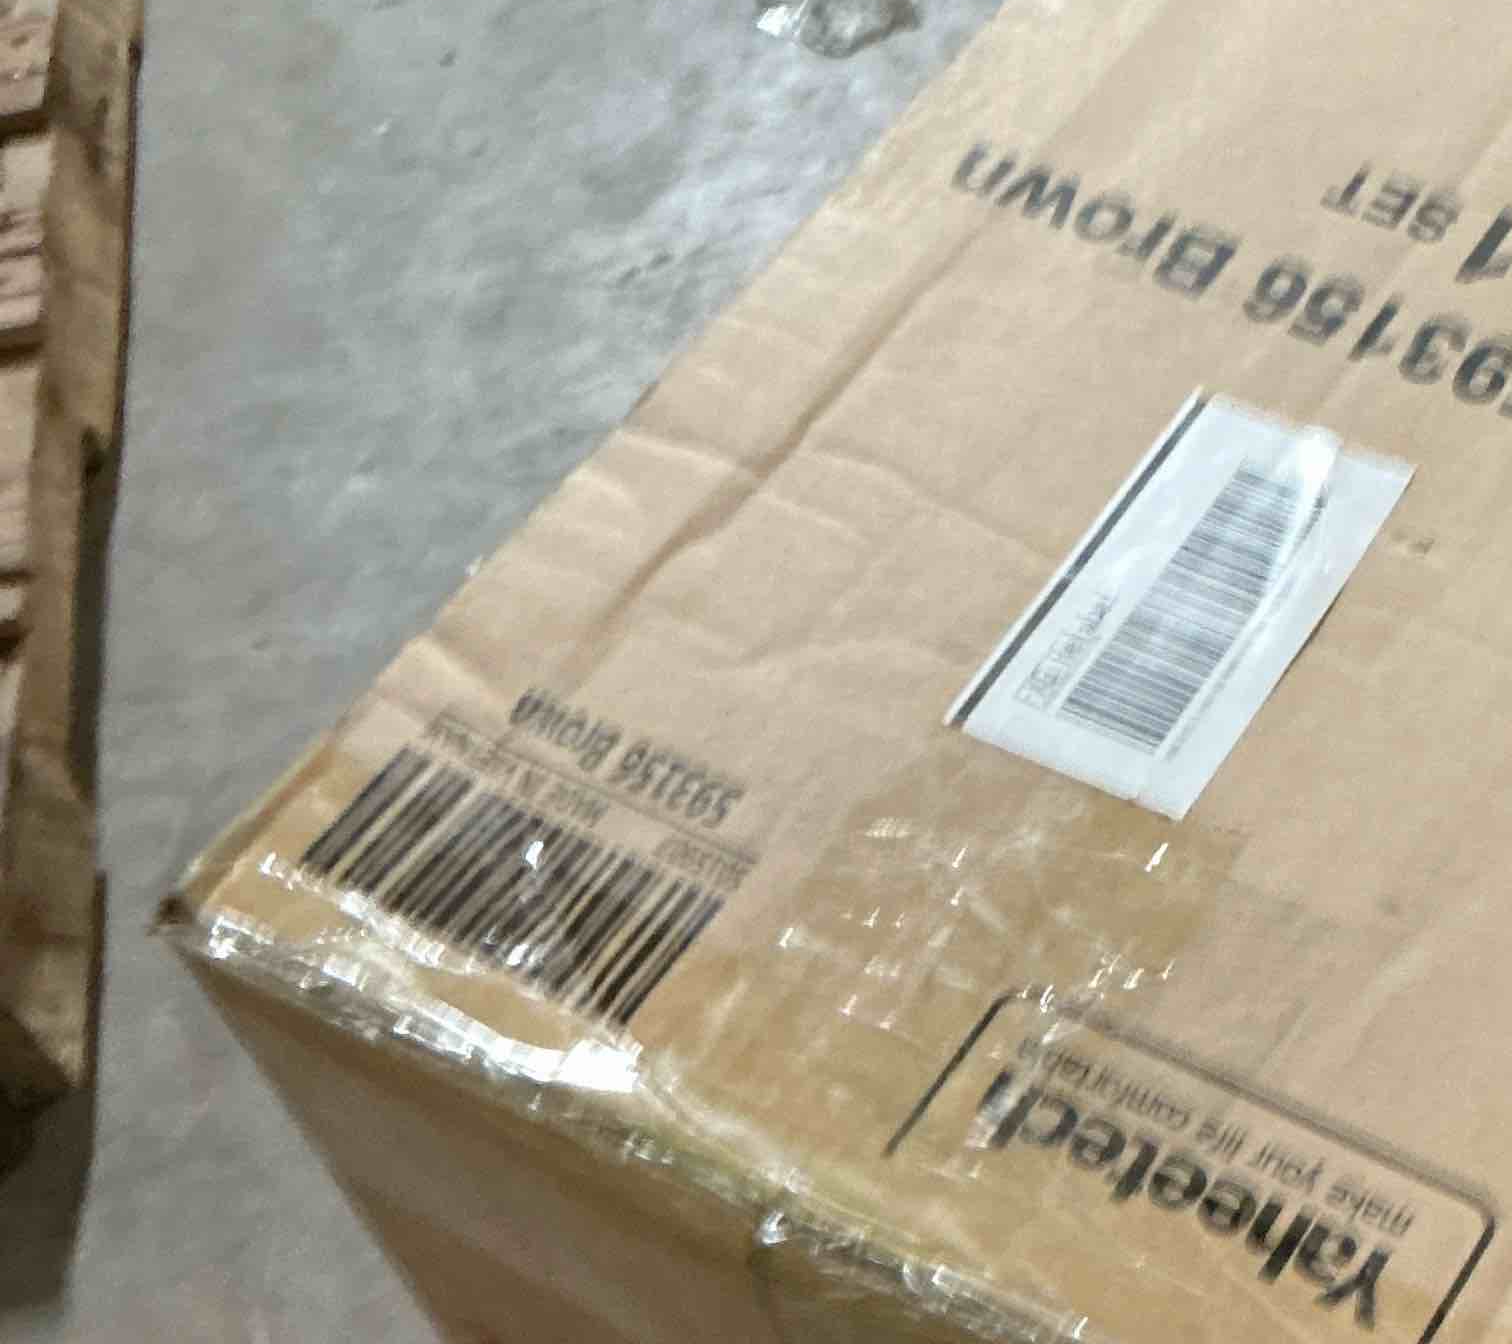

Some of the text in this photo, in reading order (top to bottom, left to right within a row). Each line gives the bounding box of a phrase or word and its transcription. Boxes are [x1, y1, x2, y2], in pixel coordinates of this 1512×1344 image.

[949, 142, 1242, 302] Brown
[1318, 160, 1463, 244] SET
[509, 687, 624, 772] Brown
[606, 740, 748, 829] 593156
[964, 1067, 1394, 1331] Yaheetech
[1254, 1136, 1328, 1195] your
[1326, 1179, 1416, 1237] make
